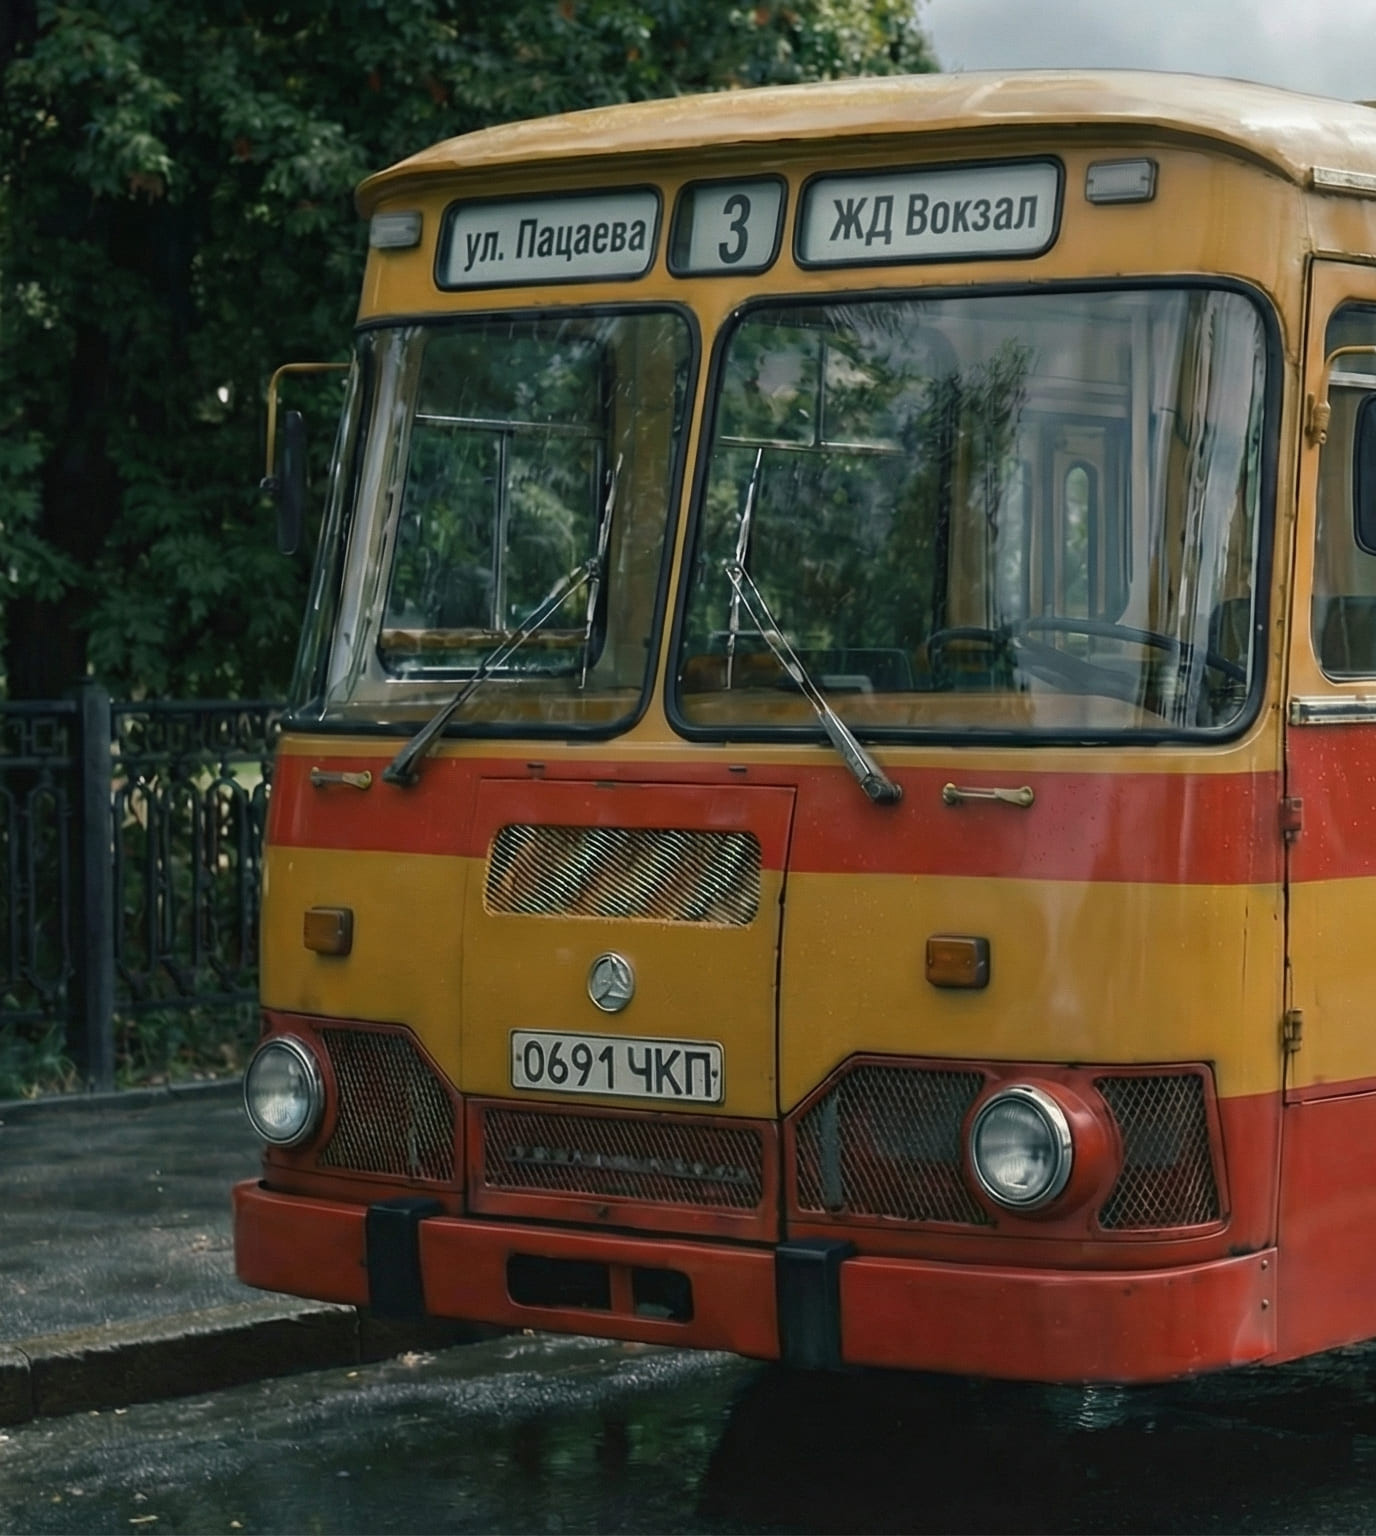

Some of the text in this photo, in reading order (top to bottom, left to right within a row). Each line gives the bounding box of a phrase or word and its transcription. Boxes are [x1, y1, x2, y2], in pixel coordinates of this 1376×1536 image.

[464, 218, 647, 272] ул. Пацаева
[718, 193, 751, 264] 3
[829, 193, 1038, 246] ЖД Вокзал
[523, 1040, 712, 1098] 0691 ЧКП
